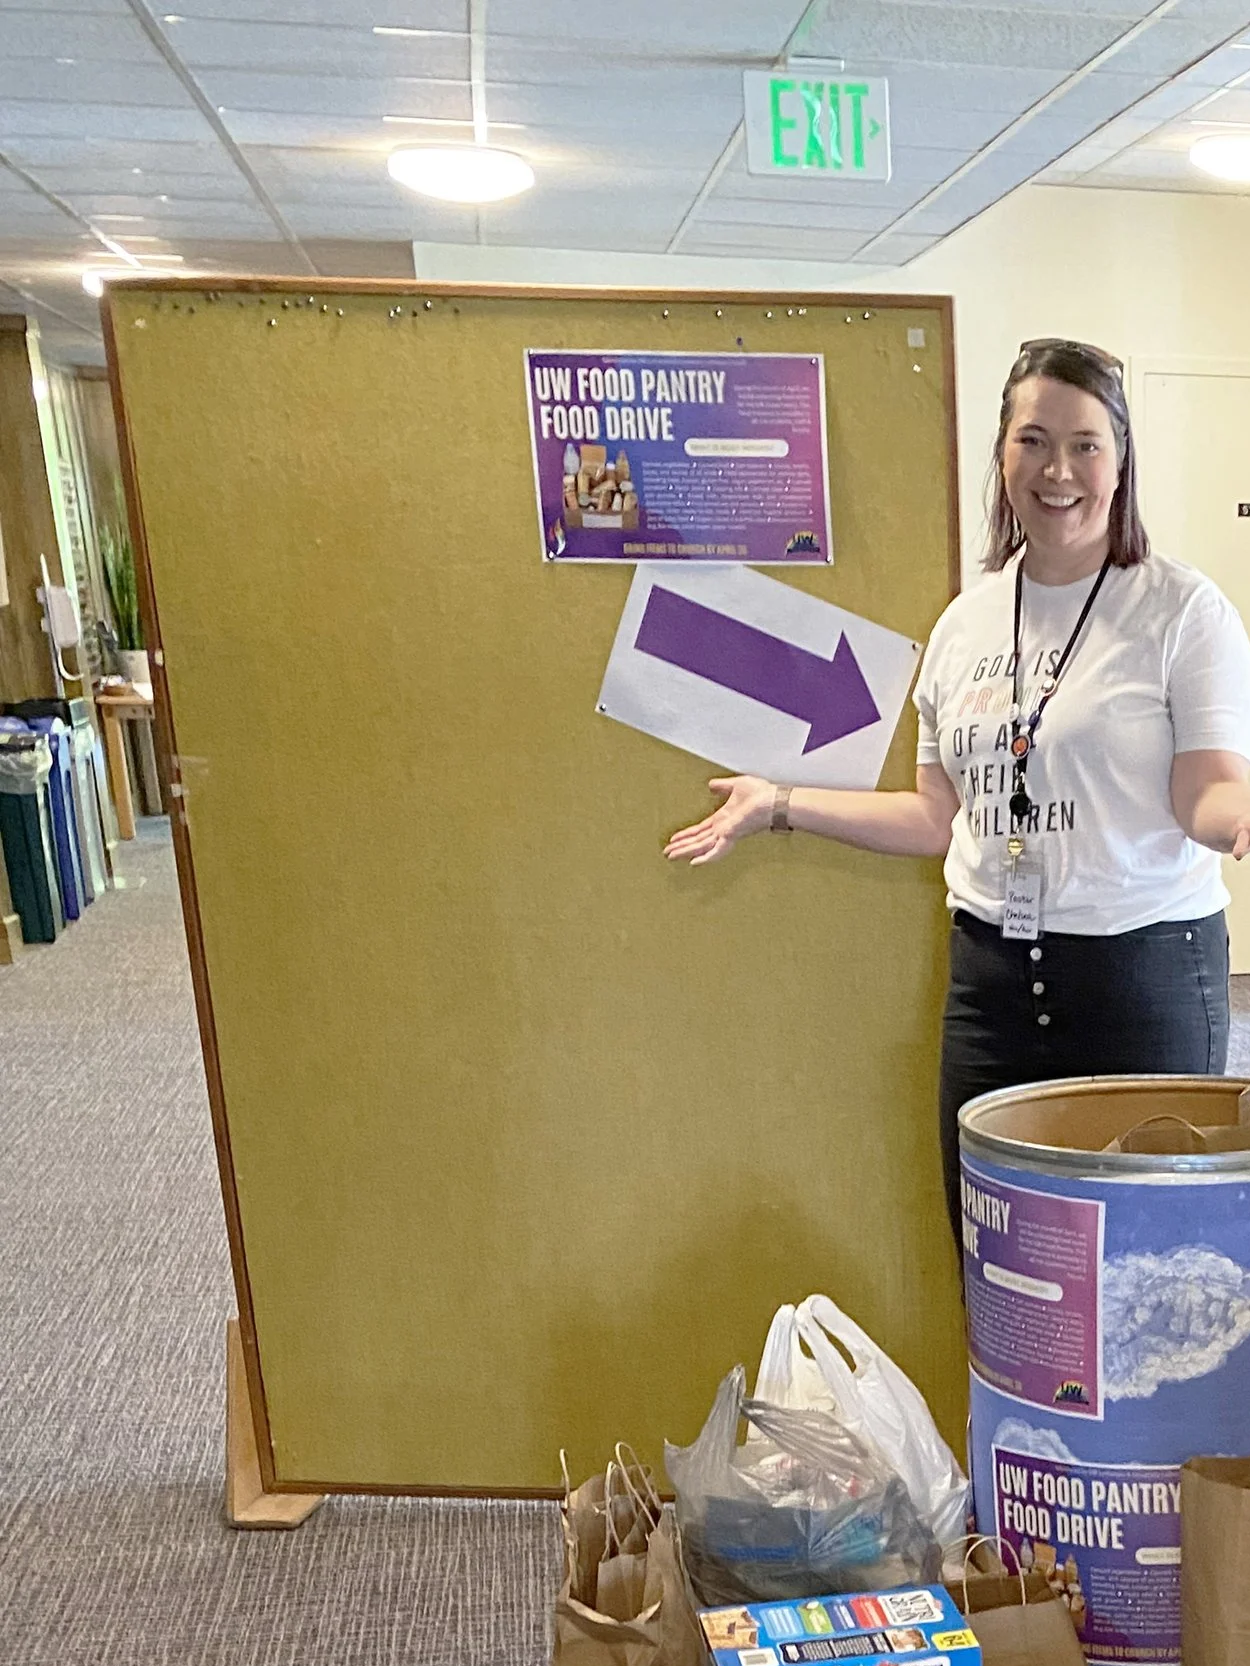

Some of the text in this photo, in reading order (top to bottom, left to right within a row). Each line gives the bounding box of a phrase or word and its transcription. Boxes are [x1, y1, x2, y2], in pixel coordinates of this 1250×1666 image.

[769, 79, 869, 171] EXIT
[534, 367, 726, 404] UW FOOD PANTRY
[540, 404, 675, 442] FOOD DRIVE
[973, 650, 1061, 682] GOD IS
[953, 724, 979, 758] OF
[1000, 1462, 1027, 1498] UW
[1033, 1471, 1085, 1509] FOOD
[1004, 1498, 1124, 1550] FOOD DRIVE
